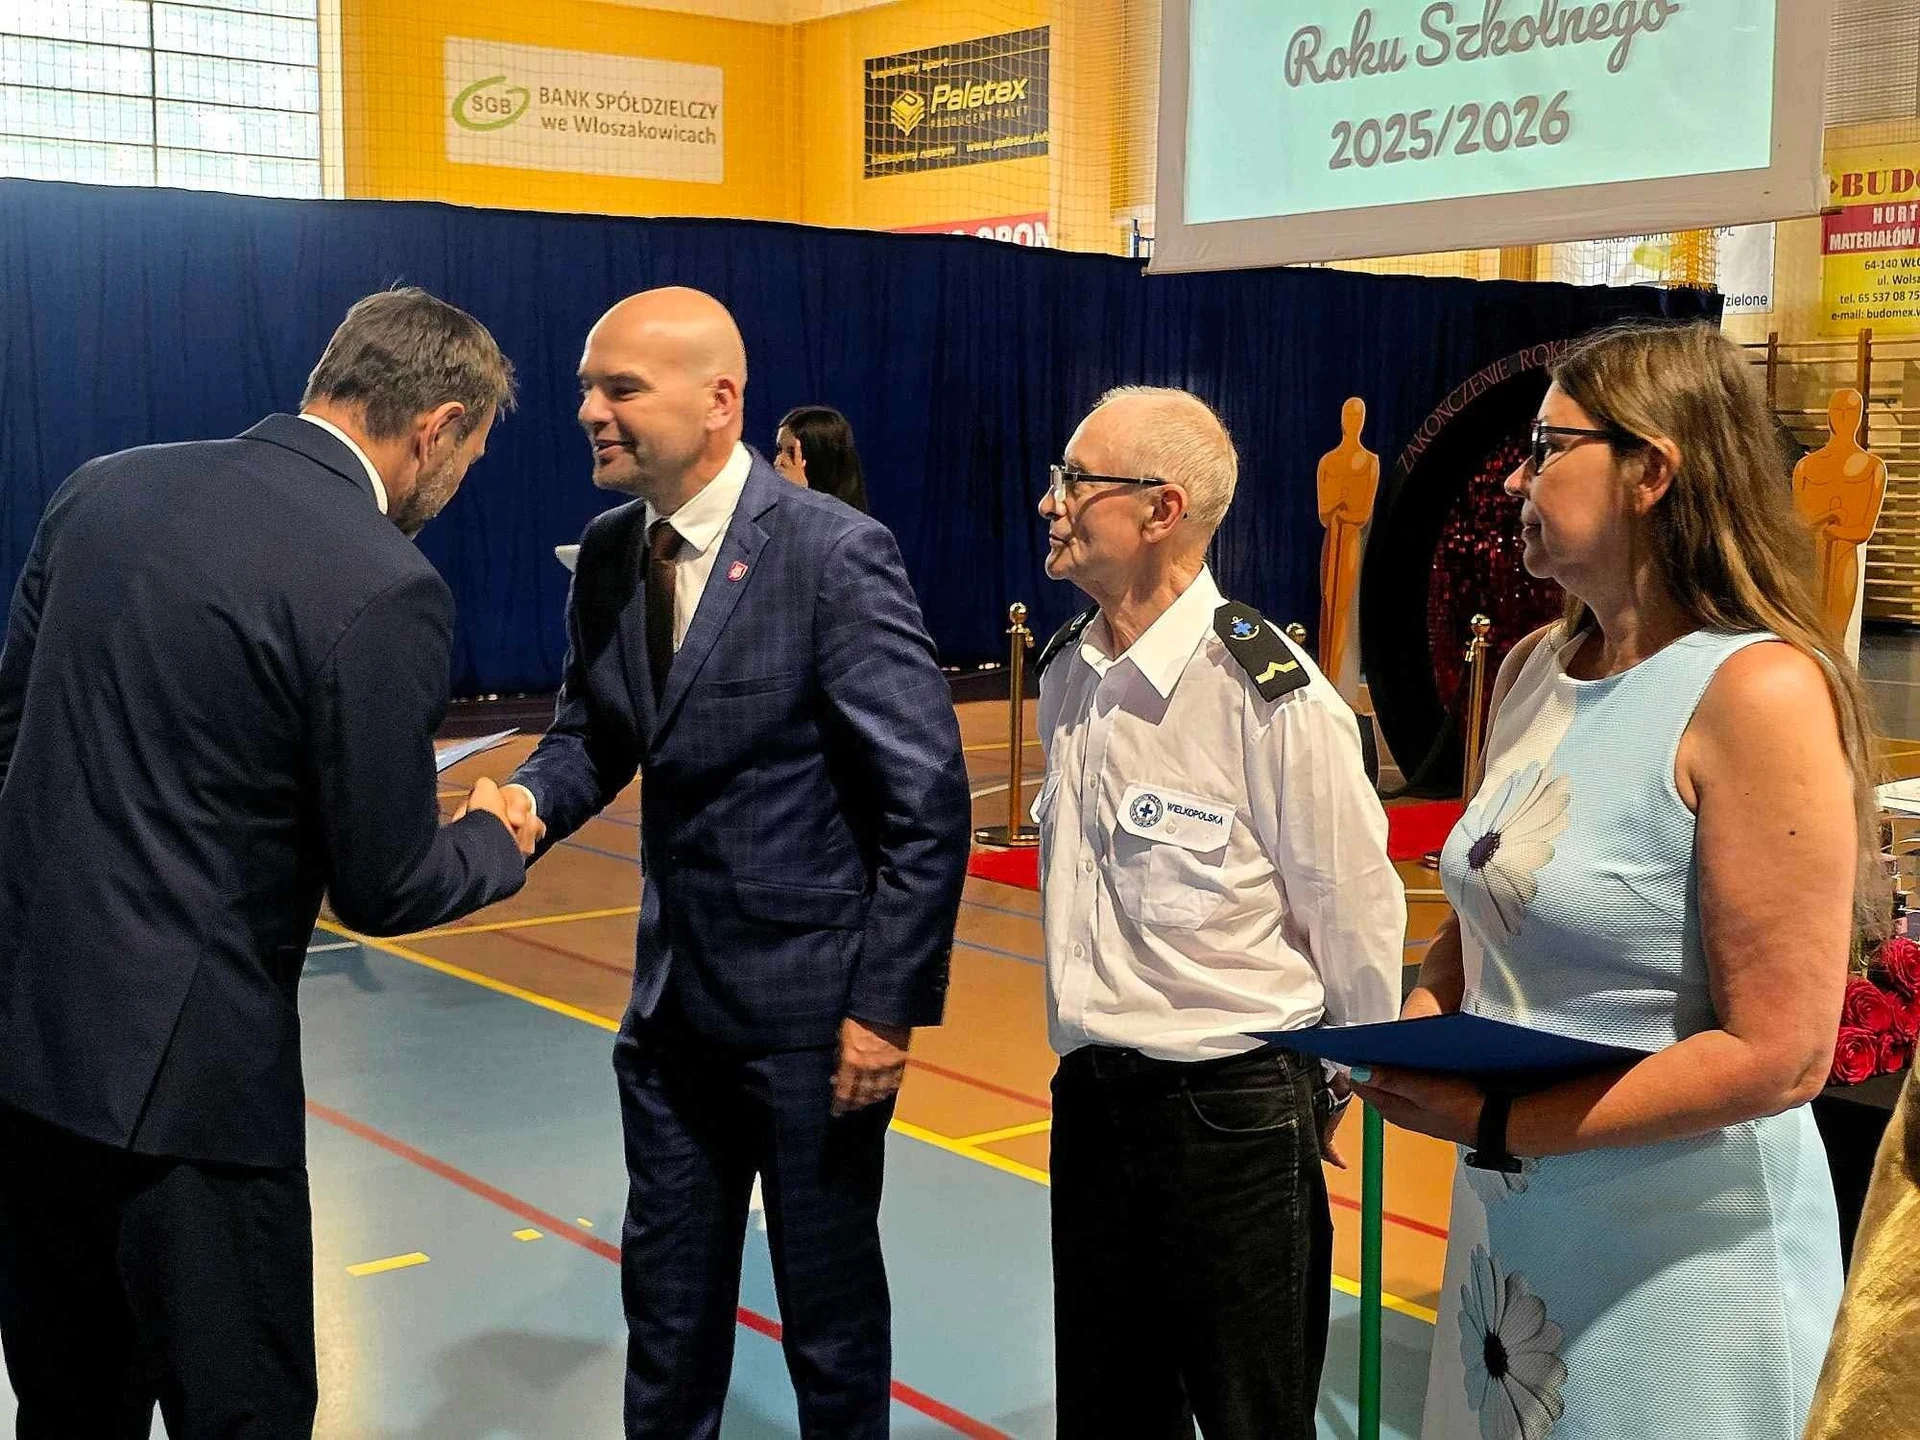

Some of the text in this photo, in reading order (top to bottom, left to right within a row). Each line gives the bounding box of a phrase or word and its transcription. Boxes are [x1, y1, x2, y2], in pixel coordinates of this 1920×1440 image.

[1284, 0, 1680, 86] Roku Szkolnego
[471, 94, 512, 115] SGB
[539, 86, 718, 121] BANK SPÓŁDZIELCZY
[930, 78, 1028, 114] Paletex
[540, 115, 568, 132] we
[1328, 90, 1571, 170] 2025/2026
[1872, 203, 1919, 225] HURT
[1829, 225, 1916, 251] MATERIAŁÓW
[1864, 259, 1899, 270] 64-140
[1877, 275, 1889, 286] ul.
[1725, 294, 1768, 307] zielone
[1840, 290, 1920, 304] tel. 65 537 08 75
[1831, 310, 1864, 320] e-mail:
